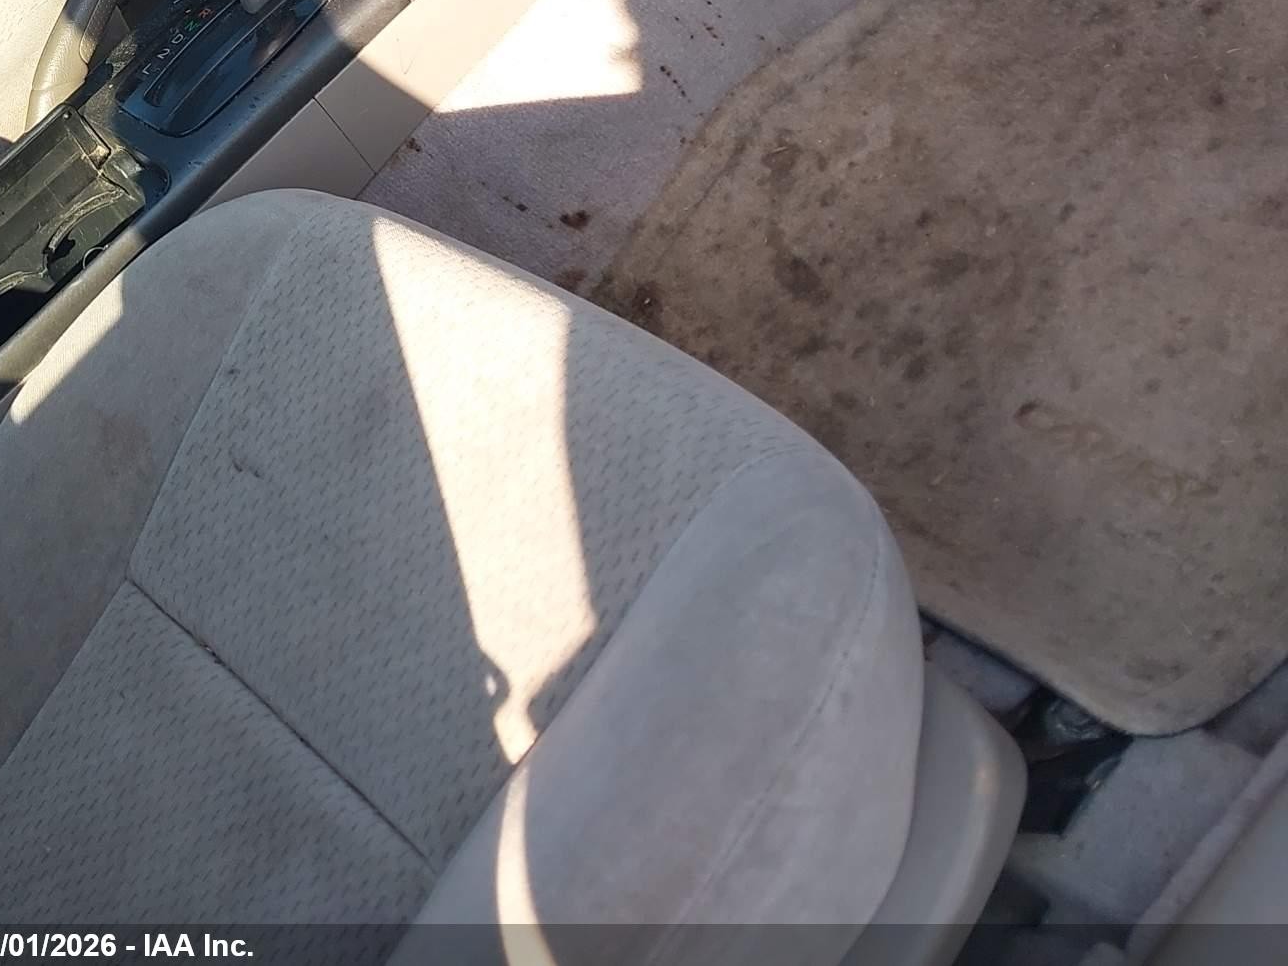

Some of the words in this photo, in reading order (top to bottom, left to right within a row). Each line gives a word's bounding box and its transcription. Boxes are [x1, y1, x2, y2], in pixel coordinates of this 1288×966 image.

[198, 8, 213, 19] R
[184, 20, 201, 32] N
[171, 33, 184, 44] D
[156, 48, 170, 59] 2
[142, 63, 152, 75] L
